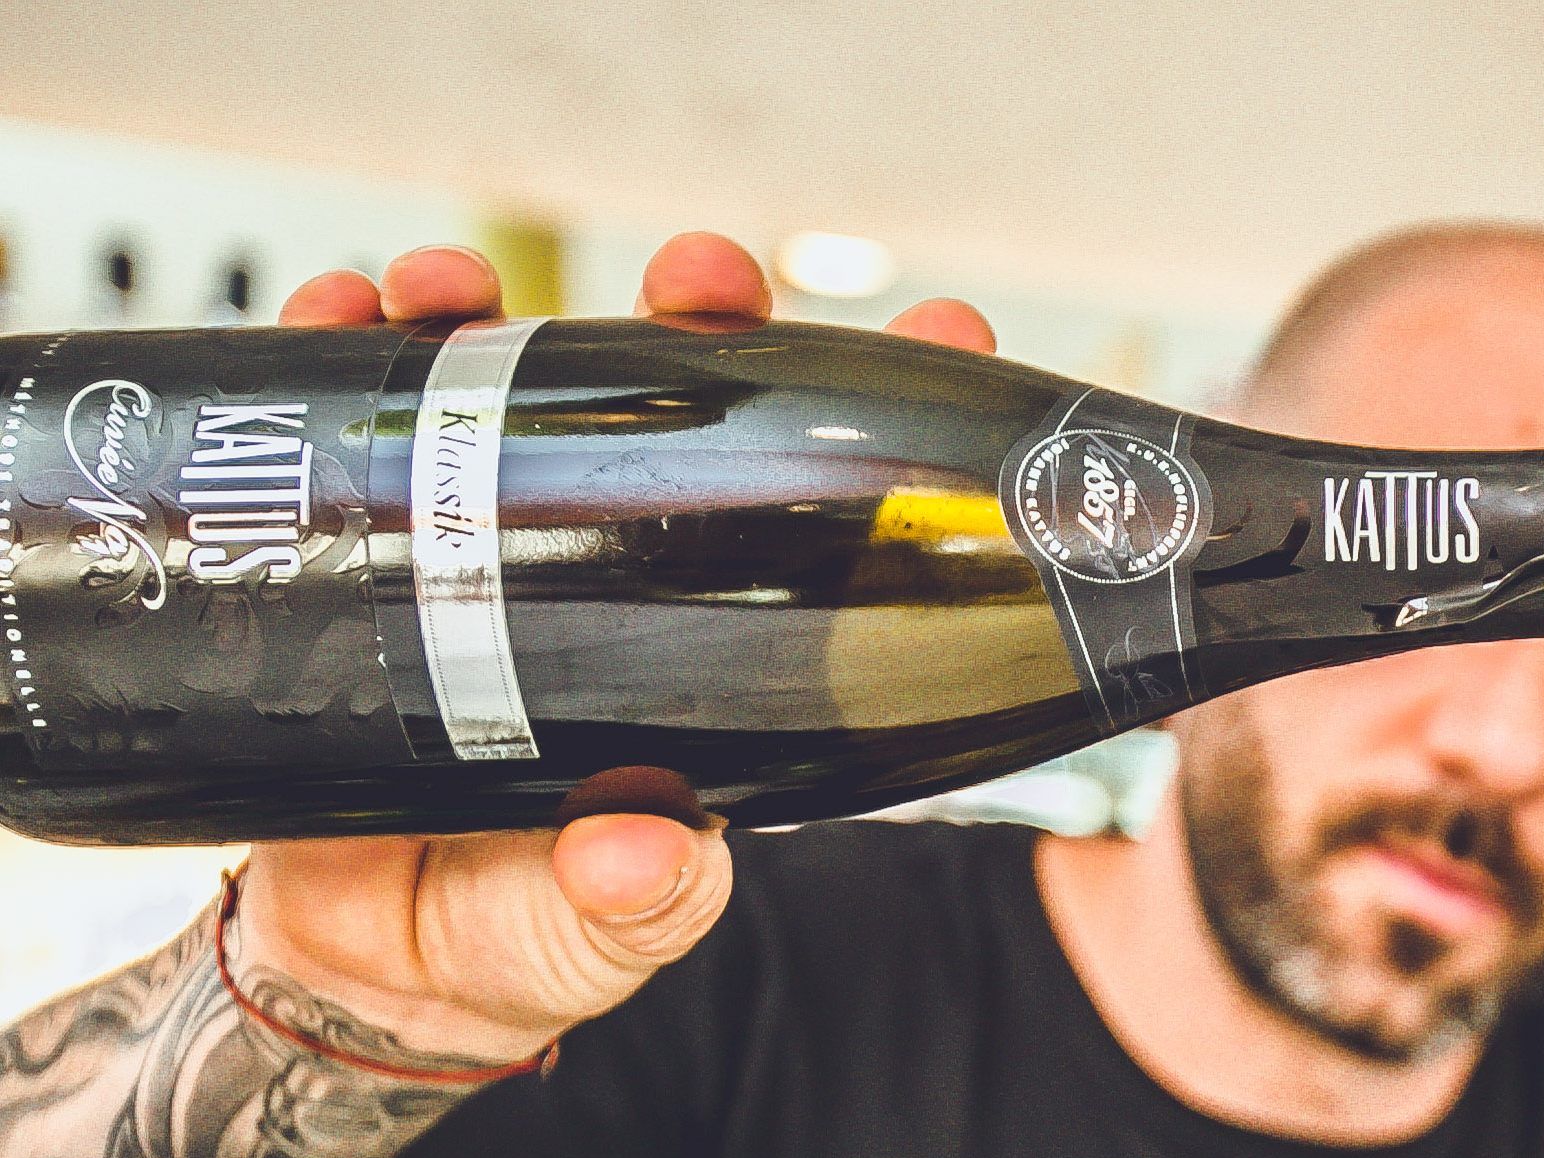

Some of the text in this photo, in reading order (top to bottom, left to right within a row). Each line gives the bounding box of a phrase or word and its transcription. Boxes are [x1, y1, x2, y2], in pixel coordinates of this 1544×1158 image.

[179, 403, 313, 583] KATTUS
[433, 408, 478, 550] Klassik
[1077, 454, 1120, 549] 1857
[1324, 470, 1480, 571] KATTUS
